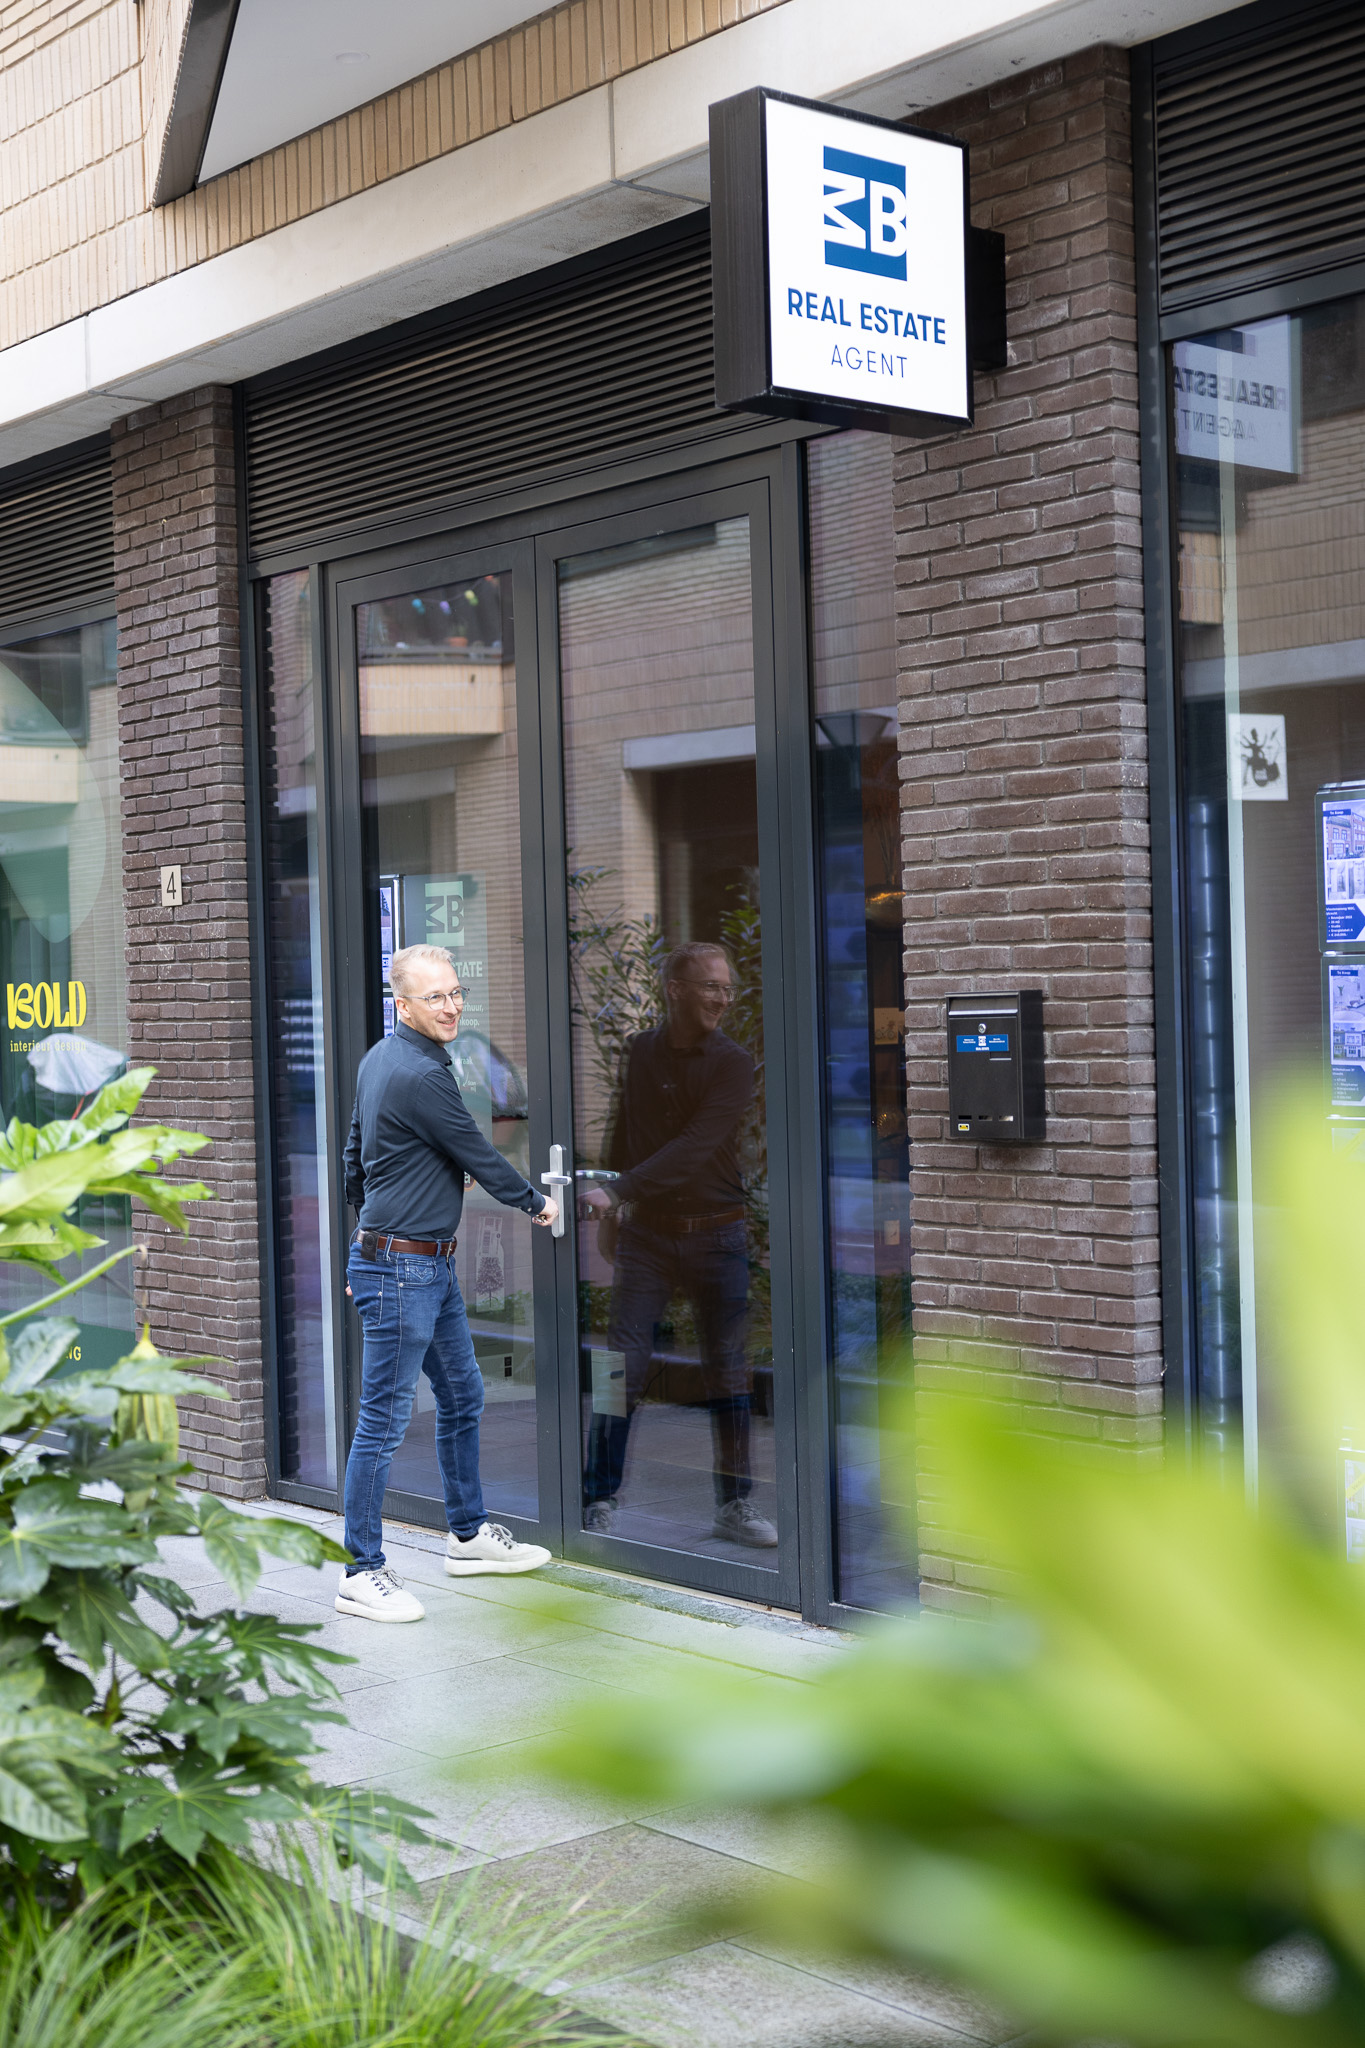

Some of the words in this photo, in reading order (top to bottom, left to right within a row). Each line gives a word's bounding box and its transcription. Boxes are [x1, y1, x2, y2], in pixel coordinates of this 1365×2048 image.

[787, 287, 852, 327] REAL
[860, 302, 946, 345] ESTATE
[831, 344, 908, 378] AGENT
[166, 871, 177, 900] 4
[452, 960, 483, 978] TATE
[6, 980, 87, 1030] BOLD
[10, 1040, 51, 1053] interieur
[54, 1040, 87, 1055] design
